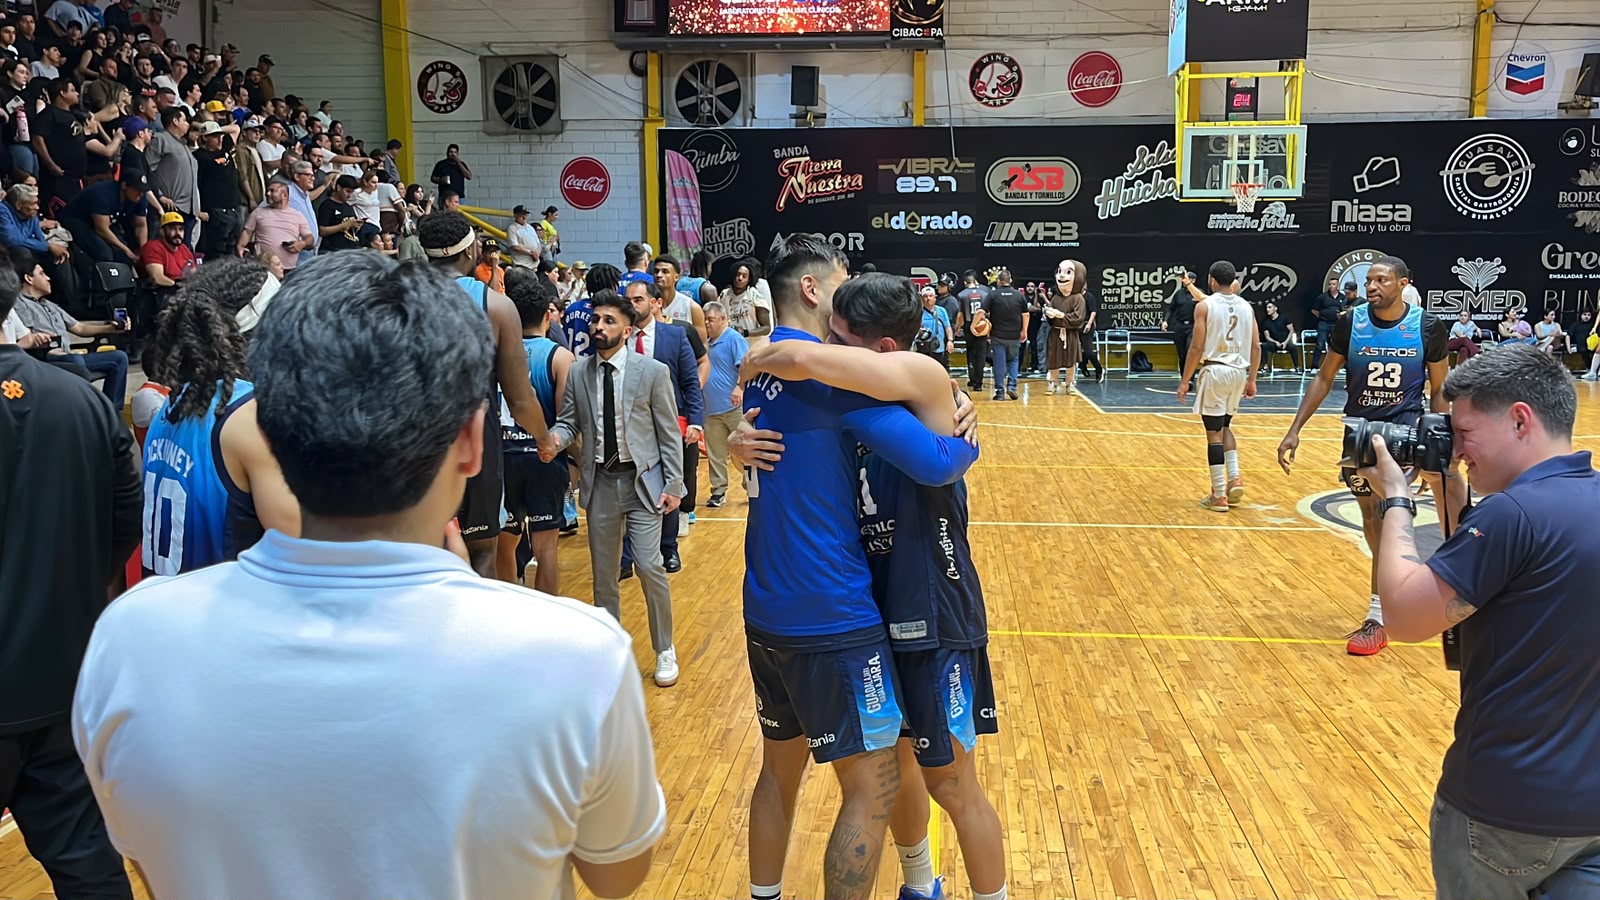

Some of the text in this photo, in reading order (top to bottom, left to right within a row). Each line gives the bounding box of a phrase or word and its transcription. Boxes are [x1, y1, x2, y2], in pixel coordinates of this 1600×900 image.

[1507, 54, 1546, 62] Chevron
[1233, 94, 1250, 106] 24
[773, 145, 809, 158] BANDA
[1458, 144, 1519, 168] GUASAVE
[778, 156, 842, 183] Tierra
[878, 157, 975, 175] VIBRA
[776, 174, 863, 211] Nuestra
[896, 175, 957, 193] 89.7
[1455, 177, 1471, 204] CAPITAL
[1035, 191, 1066, 199] TORNILLOS
[1095, 170, 1179, 219] Huicho
[1330, 198, 1412, 222] Niasa
[1457, 206, 1514, 220] DE SINALOA
[1330, 222, 1411, 234] Entre tu y tu obra
[1541, 243, 1600, 270] Gre
[1102, 267, 1162, 286] Salud
[1101, 287, 1121, 296] para
[1120, 286, 1164, 303] Pies
[1134, 302, 1162, 310] perfecto
[1117, 311, 1164, 321] ENRIQUE
[1226, 315, 1239, 341] 2
[1358, 346, 1417, 357] ASTROS
[1367, 361, 1402, 388] 23
[1362, 389, 1373, 397] AL
[141, 471, 187, 576] 10
